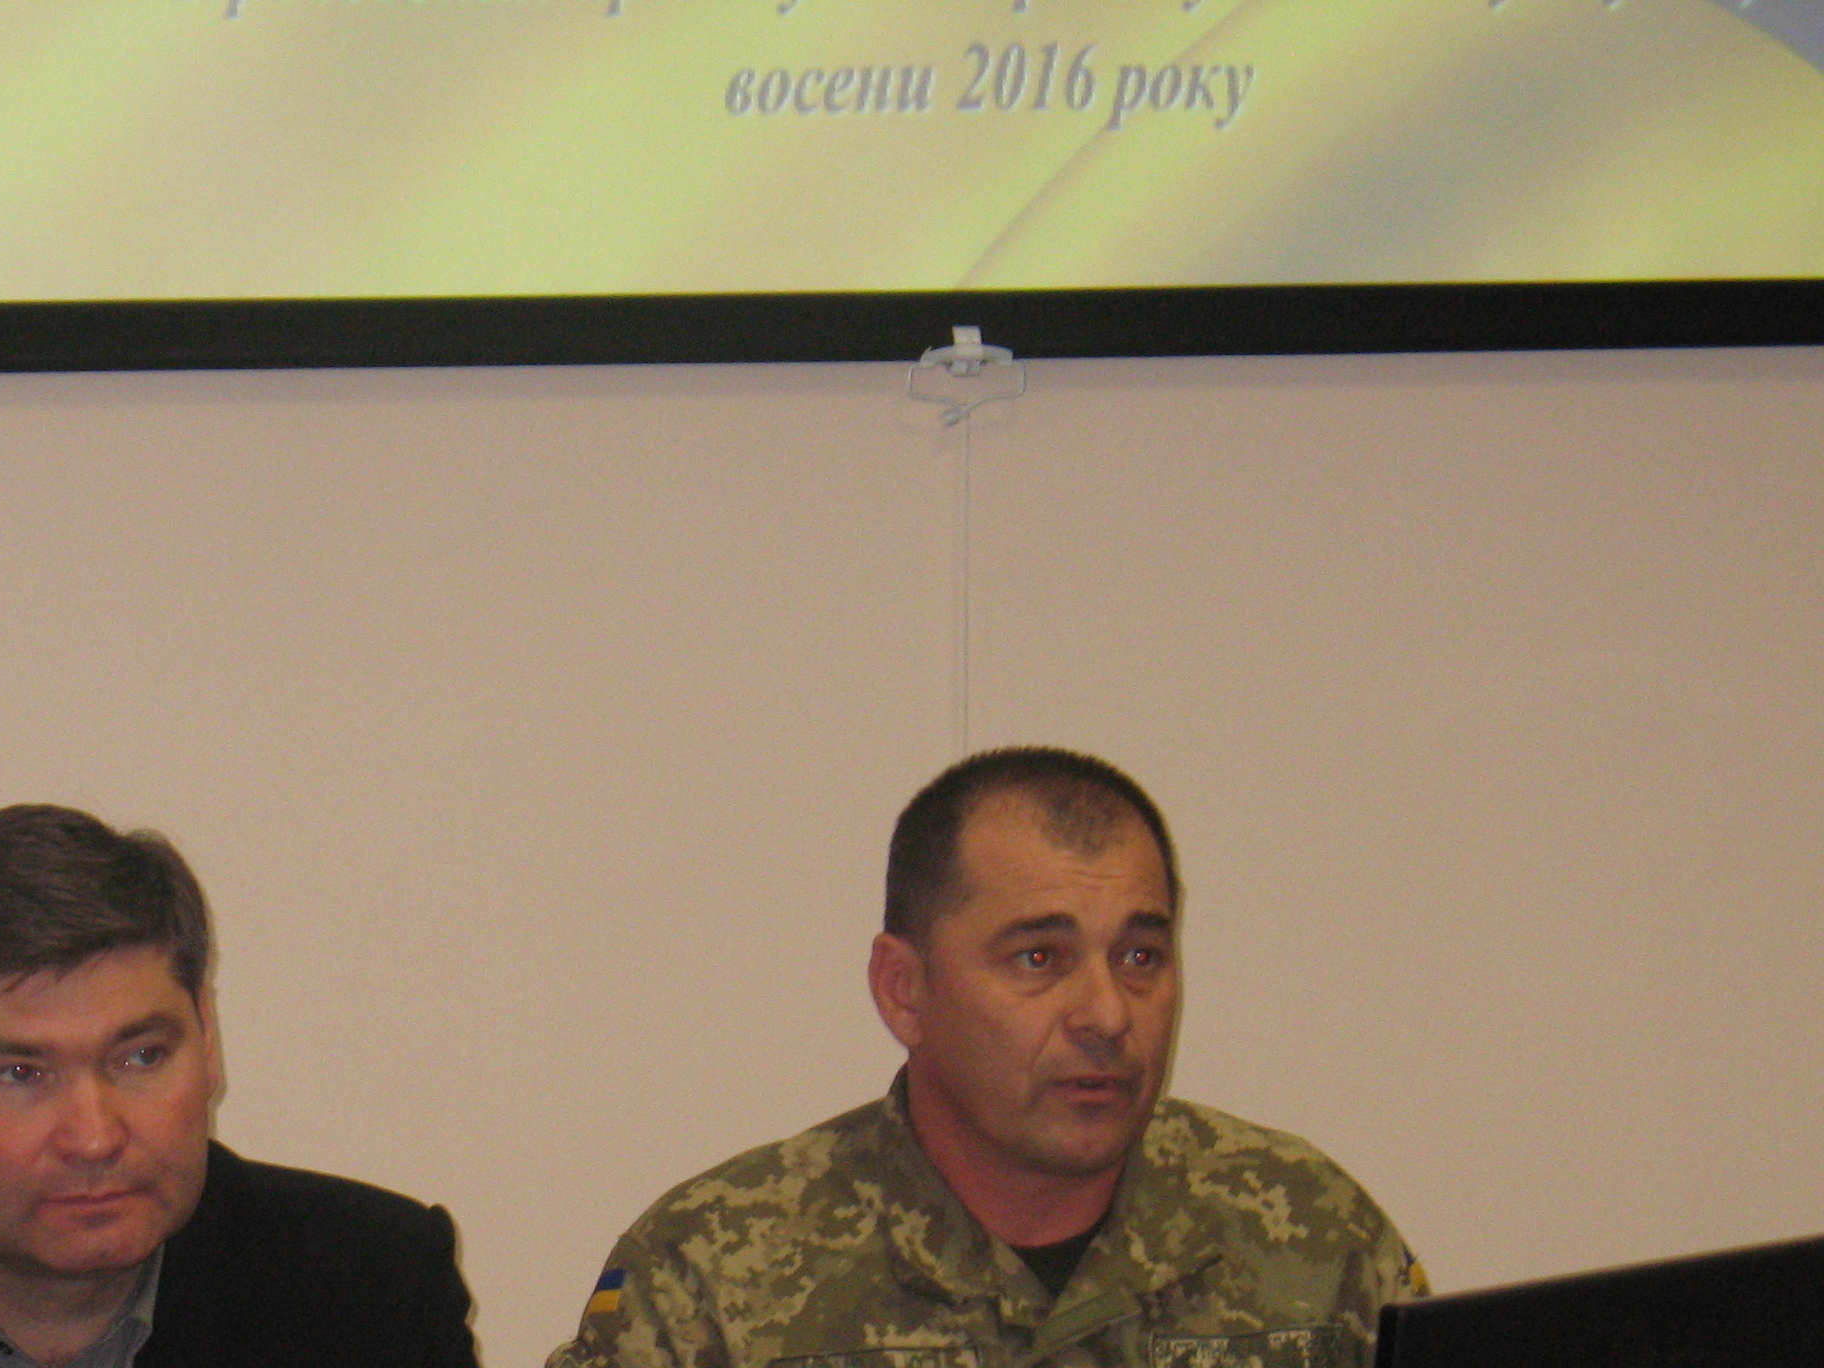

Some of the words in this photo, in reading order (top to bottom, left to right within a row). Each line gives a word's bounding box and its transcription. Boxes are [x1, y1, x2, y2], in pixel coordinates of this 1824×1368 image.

[724, 66, 934, 116] восени
[955, 40, 1099, 112] 2016
[1105, 62, 1256, 131] року
